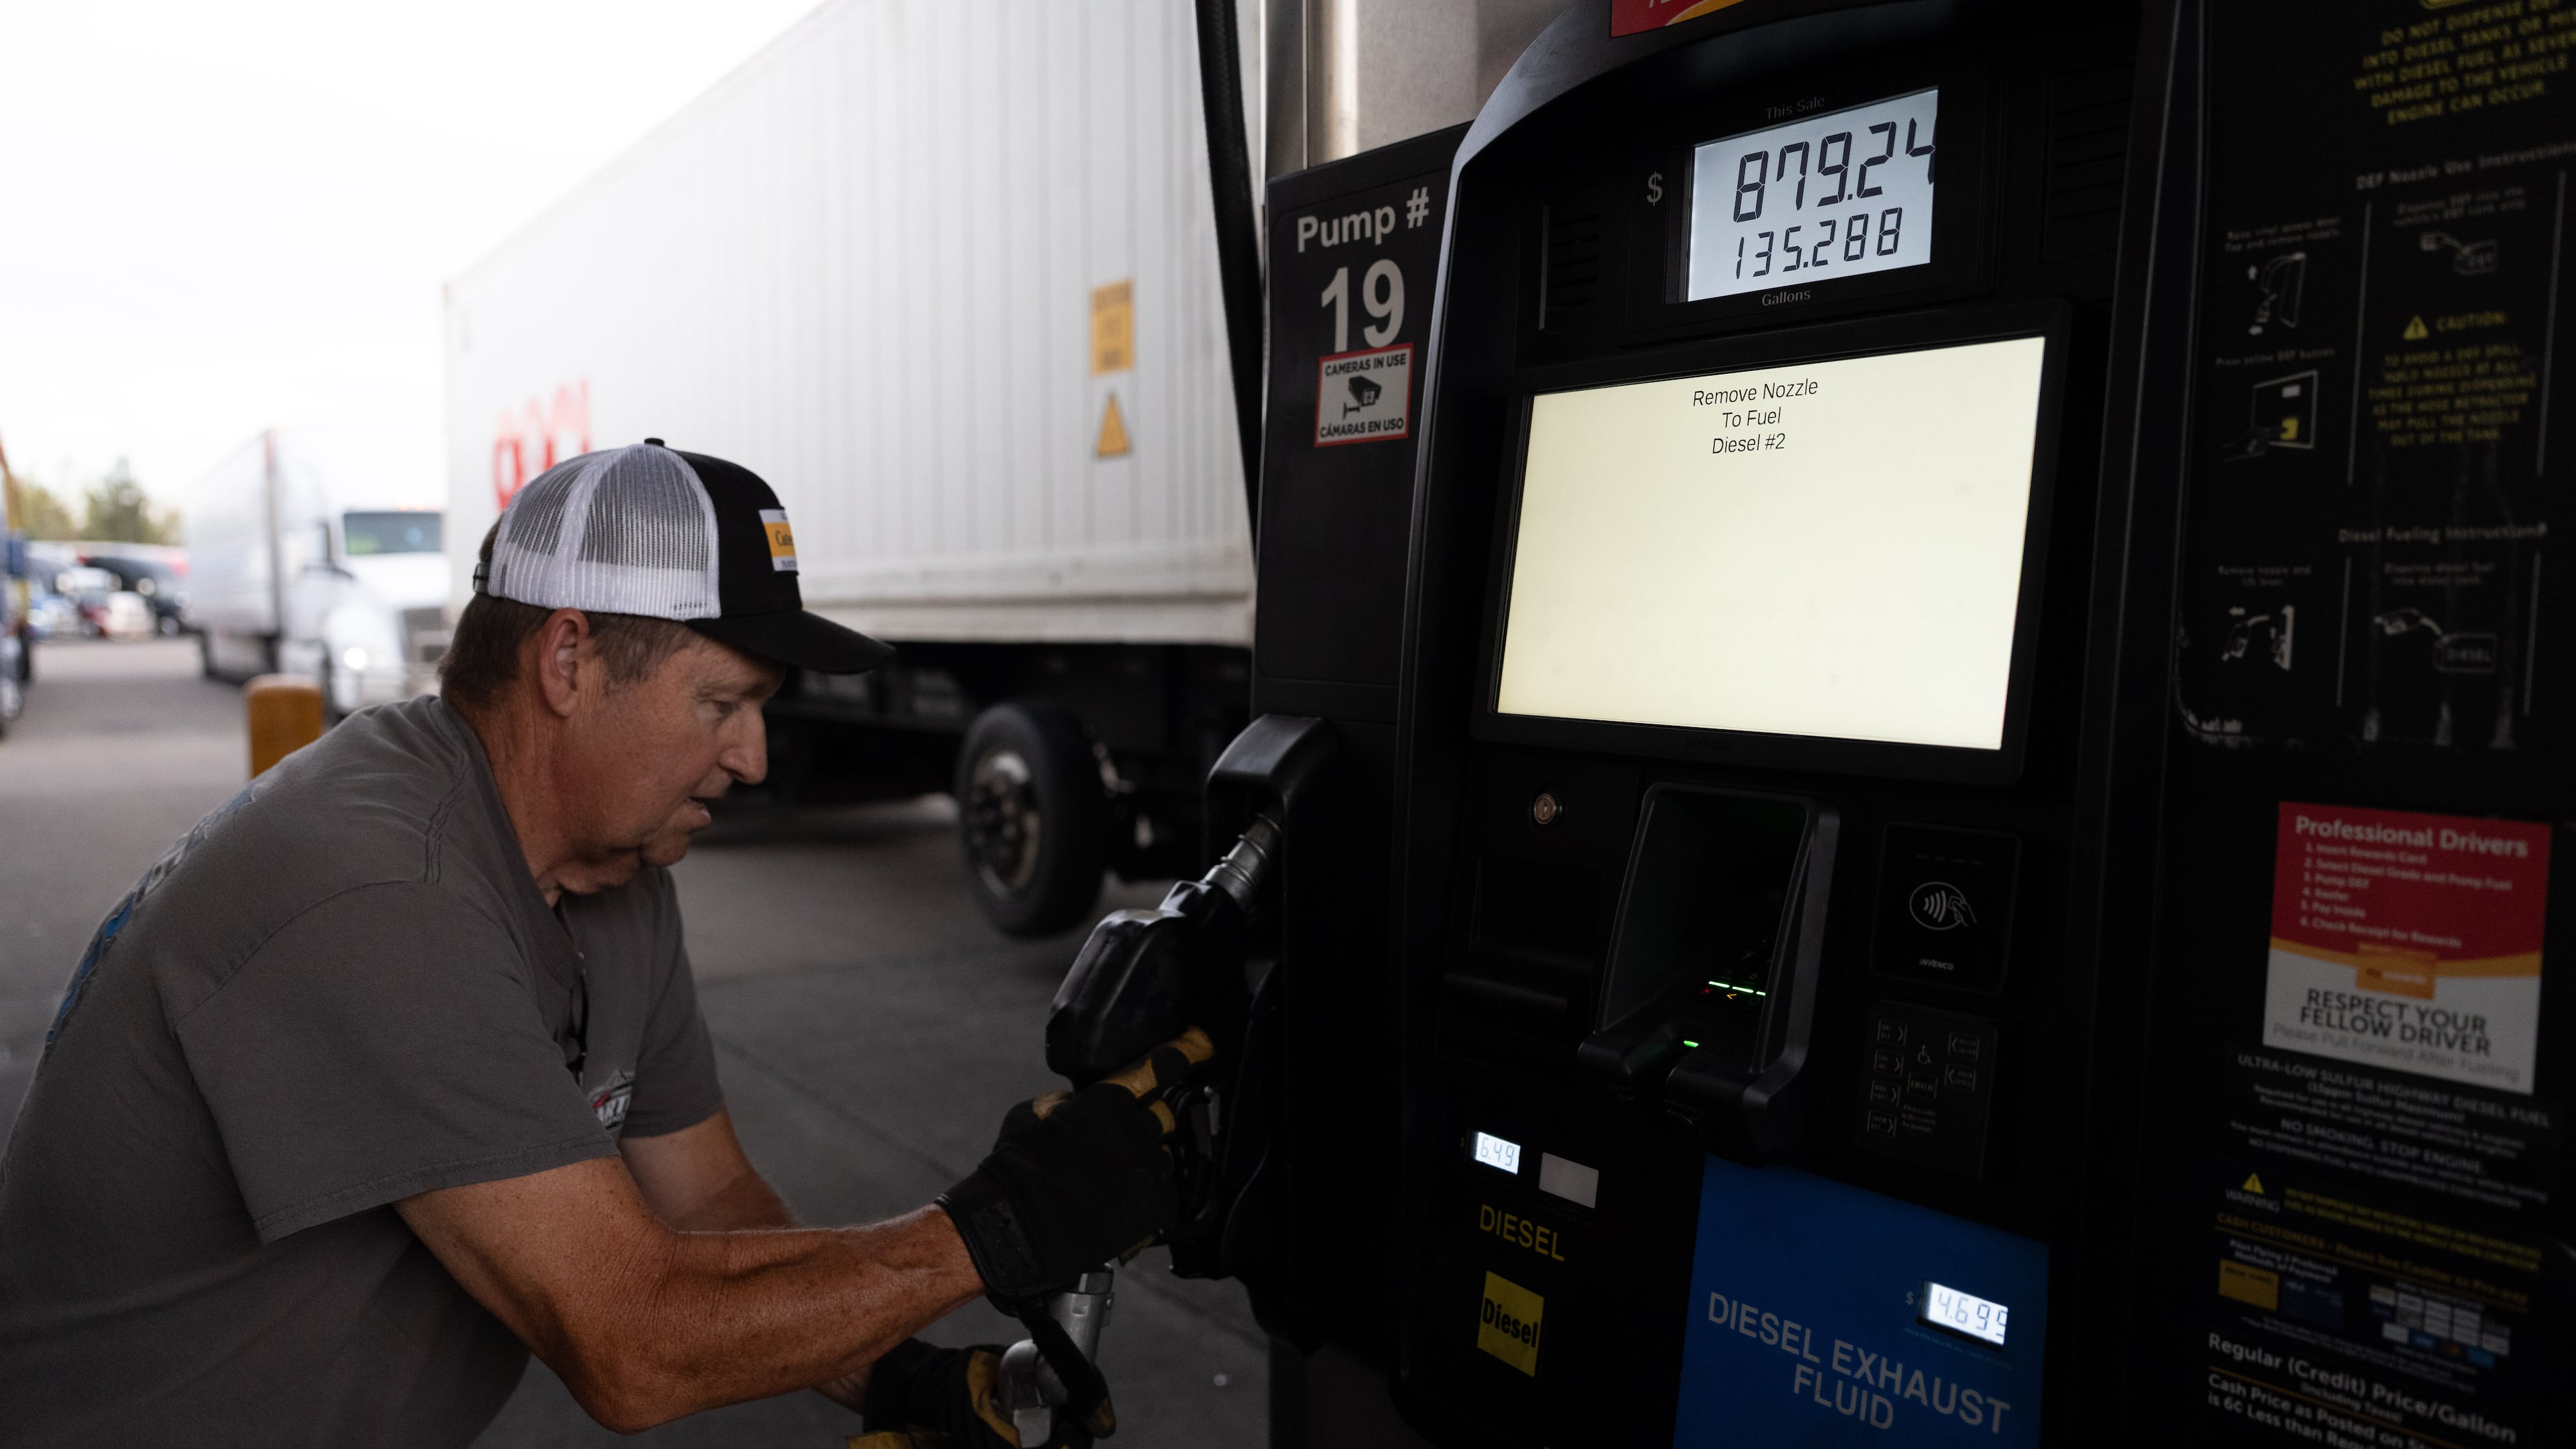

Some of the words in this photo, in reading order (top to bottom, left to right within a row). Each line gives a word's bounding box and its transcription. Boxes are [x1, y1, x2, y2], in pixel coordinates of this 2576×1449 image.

[1766, 103, 1792, 120] This
[1797, 97, 1825, 114] Sale
[1646, 170, 1663, 207] $
[1733, 117, 1936, 223] 879.24
[1297, 205, 1396, 253] Pump
[1406, 186, 1429, 229] #
[1736, 207, 1902, 279] 135.288
[1321, 258, 1405, 353] 19
[1762, 290, 1811, 307] Gallons
[1325, 360, 1371, 376] CAMERAS
[1374, 357, 1384, 368] IN
[1387, 354, 1406, 366] USE
[1693, 388, 1757, 406] Remove
[1763, 378, 1818, 399] Nozzle
[1320, 421, 1366, 438] CÁMARAS
[1368, 421, 1381, 432] EN
[1385, 418, 1403, 431] USO
[1723, 412, 1741, 428] To
[1747, 407, 1781, 426] Fuel
[1713, 434, 1761, 453] Diesel
[1765, 433, 1785, 450] #2
[2296, 814, 2434, 848] Professional
[2439, 828, 2528, 859] Drivers
[1919, 958, 1953, 971] INVENCO
[2300, 1006, 2394, 1038] FELLOW
[2400, 1024, 2491, 1058] DRIVER
[2308, 988, 2412, 1020] RESPECT
[2415, 1008, 2487, 1032] YOUR
[2237, 1053, 2318, 1079] ULTRA-LOW
[1481, 1137, 1515, 1166] 6.49
[1479, 1203, 1565, 1262] DIESEL
[1483, 1298, 1538, 1348] Diesel
[1708, 1291, 1821, 1364] DIESEL
[1831, 1339, 2011, 1434] EXHAUST
[1793, 1363, 1894, 1430] FLUID
[2208, 1331, 2283, 1370] Regular
[2287, 1355, 2367, 1398] (Credit)
[2372, 1383, 2516, 1446] Price/Gallon
[2208, 1373, 2247, 1399] Cash
[2250, 1385, 2292, 1413] Price
[2294, 1404, 2314, 1420] as
[2316, 1409, 2376, 1440] Posted
[2247, 1403, 2282, 1428] Less
[2284, 1417, 2323, 1442] than
